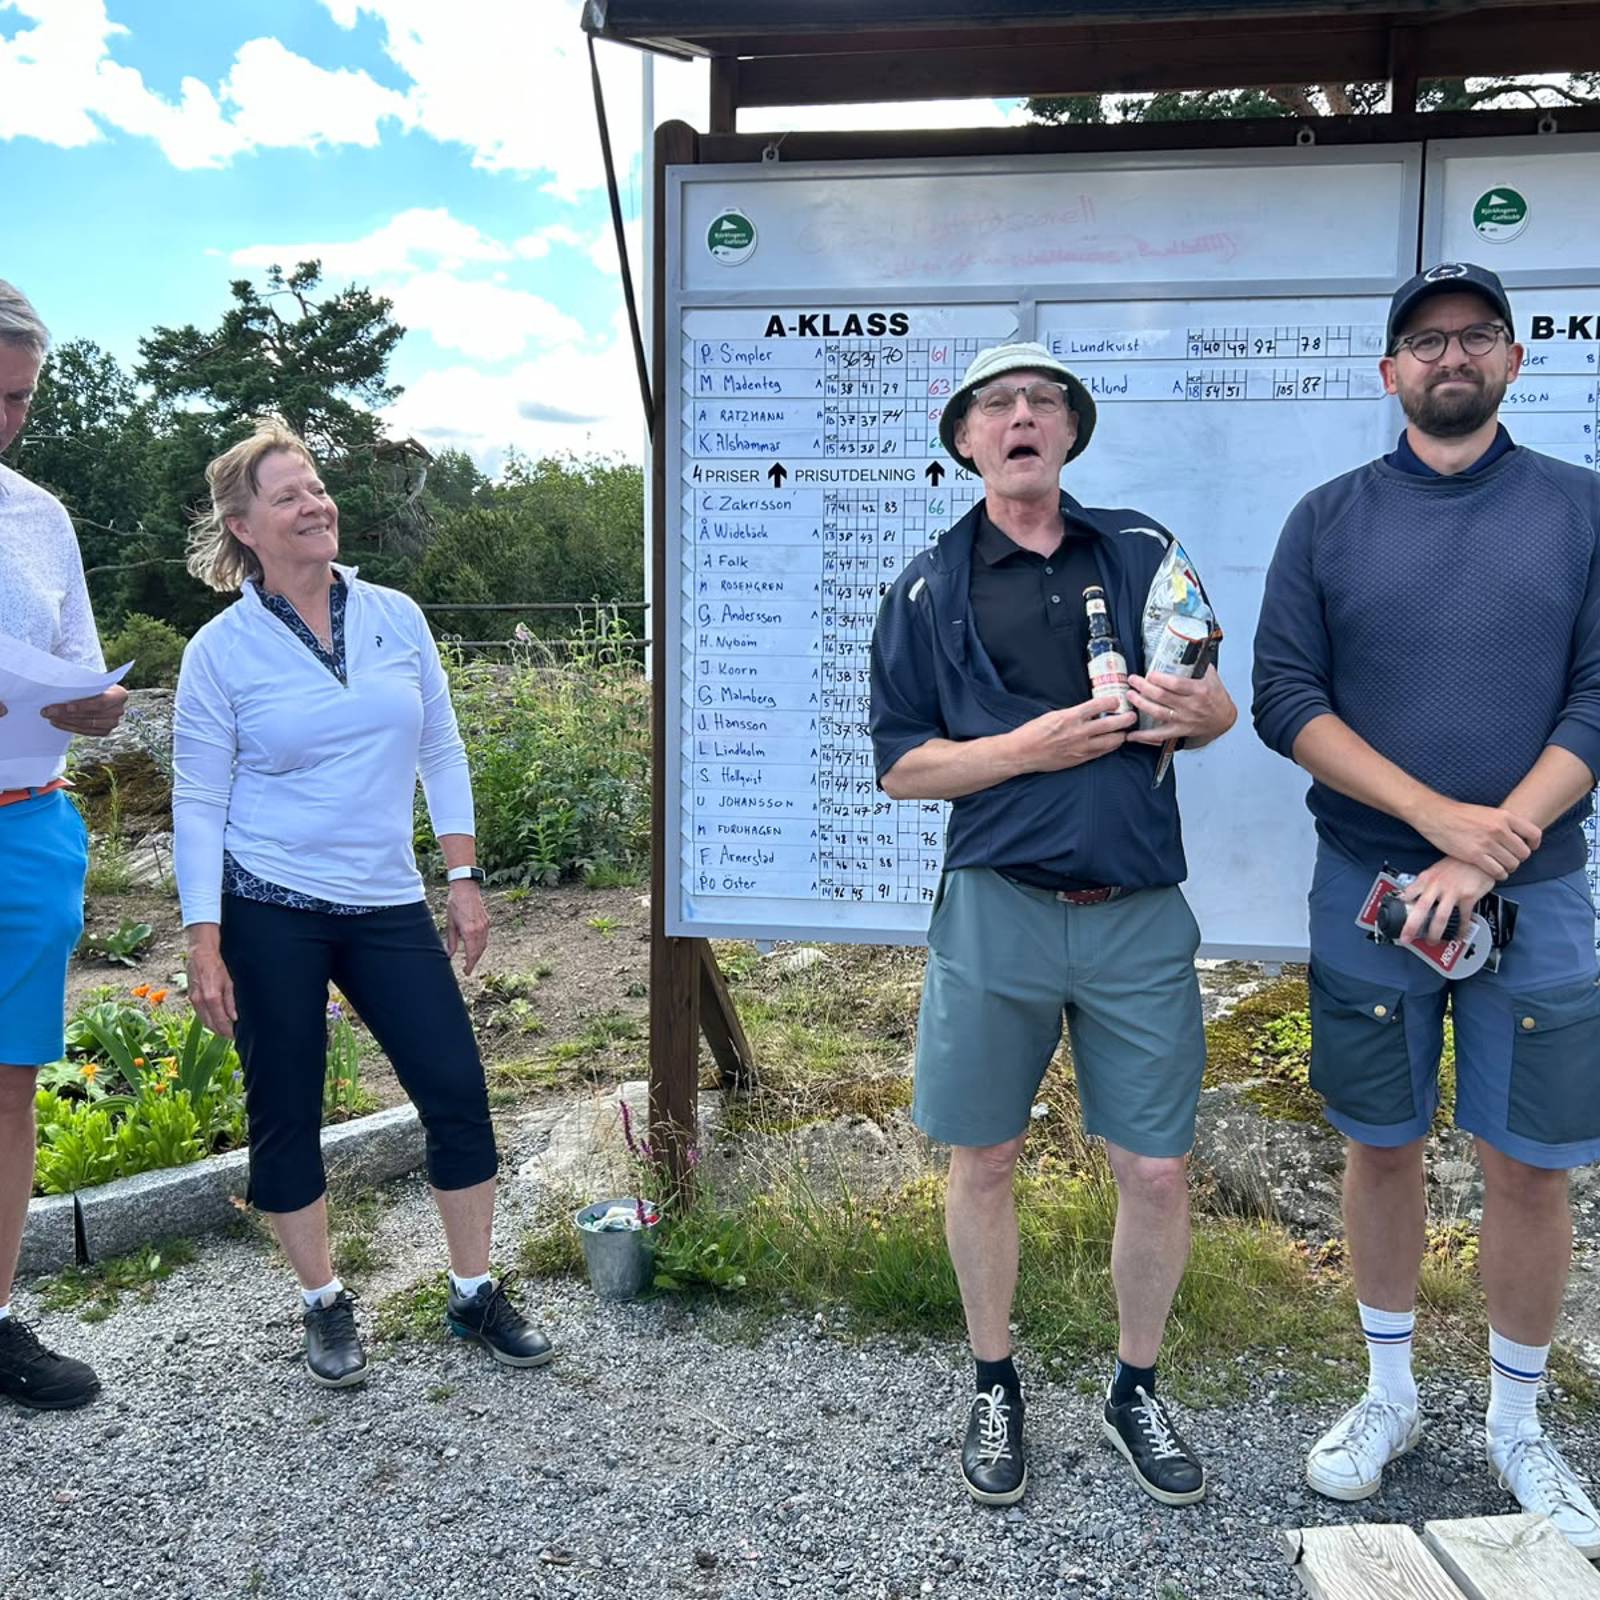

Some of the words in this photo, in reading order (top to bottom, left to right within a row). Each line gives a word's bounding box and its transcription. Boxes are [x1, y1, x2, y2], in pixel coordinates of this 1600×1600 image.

[764, 312, 909, 337] A-KLASS
[1531, 315, 1600, 340] B-K
[881, 346, 903, 364] 70
[931, 346, 947, 365] 61
[1071, 338, 1141, 353] Lundkvist
[1191, 344, 1199, 356] 9
[1203, 342, 1221, 353] 40
[1301, 336, 1321, 352] 78
[928, 378, 951, 396] 63
[1172, 380, 1184, 394] A
[1189, 386, 1200, 397] 18
[1205, 385, 1220, 398] 54
[1303, 376, 1322, 394] 87
[861, 414, 877, 427] 37
[881, 409, 904, 424] 74
[826, 443, 836, 454] 15
[706, 469, 760, 482] PRISER
[795, 468, 916, 482] PRISUTDELNING
[720, 494, 792, 511] Zakrisson
[825, 503, 837, 517] 17
[838, 503, 850, 513] 41
[862, 504, 876, 513] 42
[884, 501, 898, 513] 83
[928, 498, 945, 514] 66
[700, 518, 710, 540] Å
[719, 555, 748, 568] Falk
[720, 580, 784, 593] ROSENGREN
[858, 587, 873, 599] 44
[721, 603, 782, 623] Andersson
[825, 616, 833, 626] 8
[837, 671, 852, 682] 38
[721, 686, 777, 708] Malmberg
[834, 696, 850, 712] 41
[714, 712, 767, 731] Hansson
[822, 724, 830, 735] 3
[833, 722, 851, 738] 37
[714, 741, 765, 757] Lindholm
[835, 751, 852, 766] 47
[700, 768, 709, 782] S
[718, 796, 794, 808] JOHANSSON
[834, 806, 849, 816] 42
[854, 806, 871, 817] 47
[873, 802, 892, 815] 89
[718, 824, 782, 836] FURUHAGEN
[876, 834, 894, 845] 92
[920, 832, 938, 846] 76
[722, 873, 757, 890] Öster
[878, 883, 890, 898] 91
